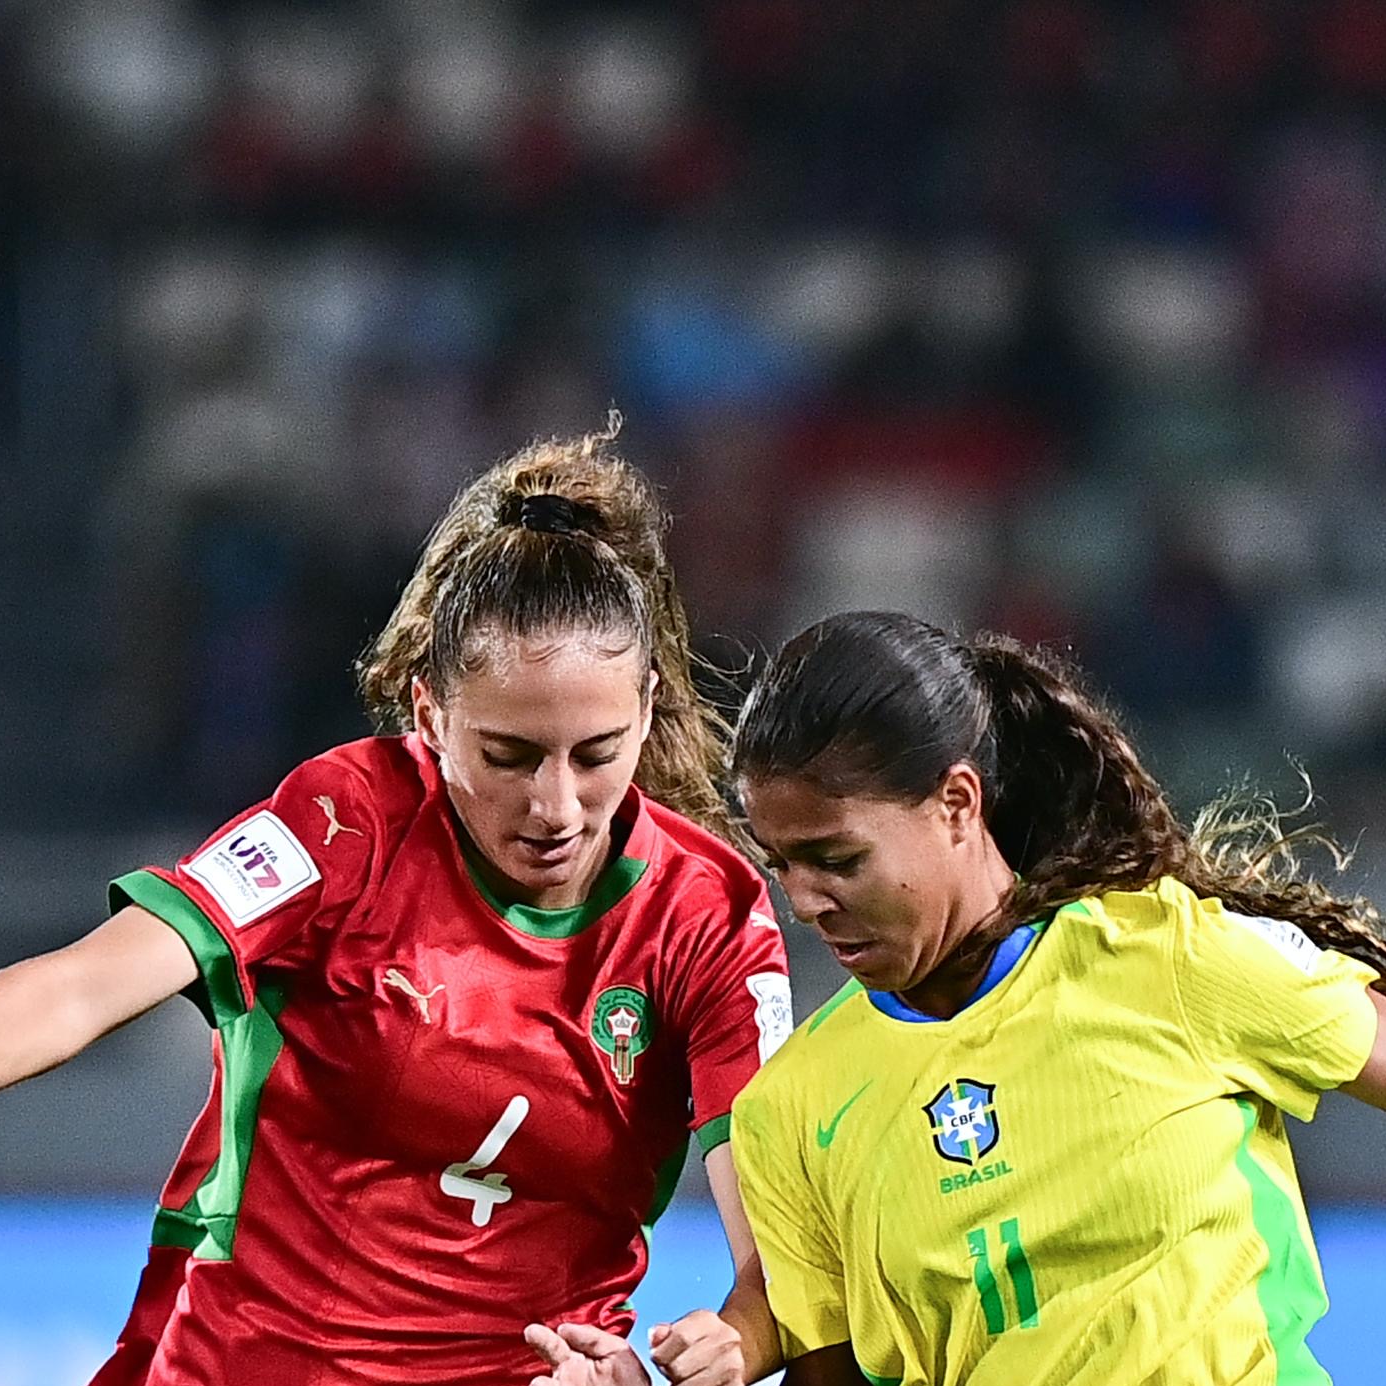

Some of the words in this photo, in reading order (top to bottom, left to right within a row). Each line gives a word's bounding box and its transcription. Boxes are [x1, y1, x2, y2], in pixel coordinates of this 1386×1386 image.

[259, 841, 279, 864] FIFA
[951, 1111, 976, 1128] CBF
[439, 1094, 531, 1228] 4
[939, 1160, 1014, 1194] BRASIL
[965, 1216, 1040, 1336] 11
